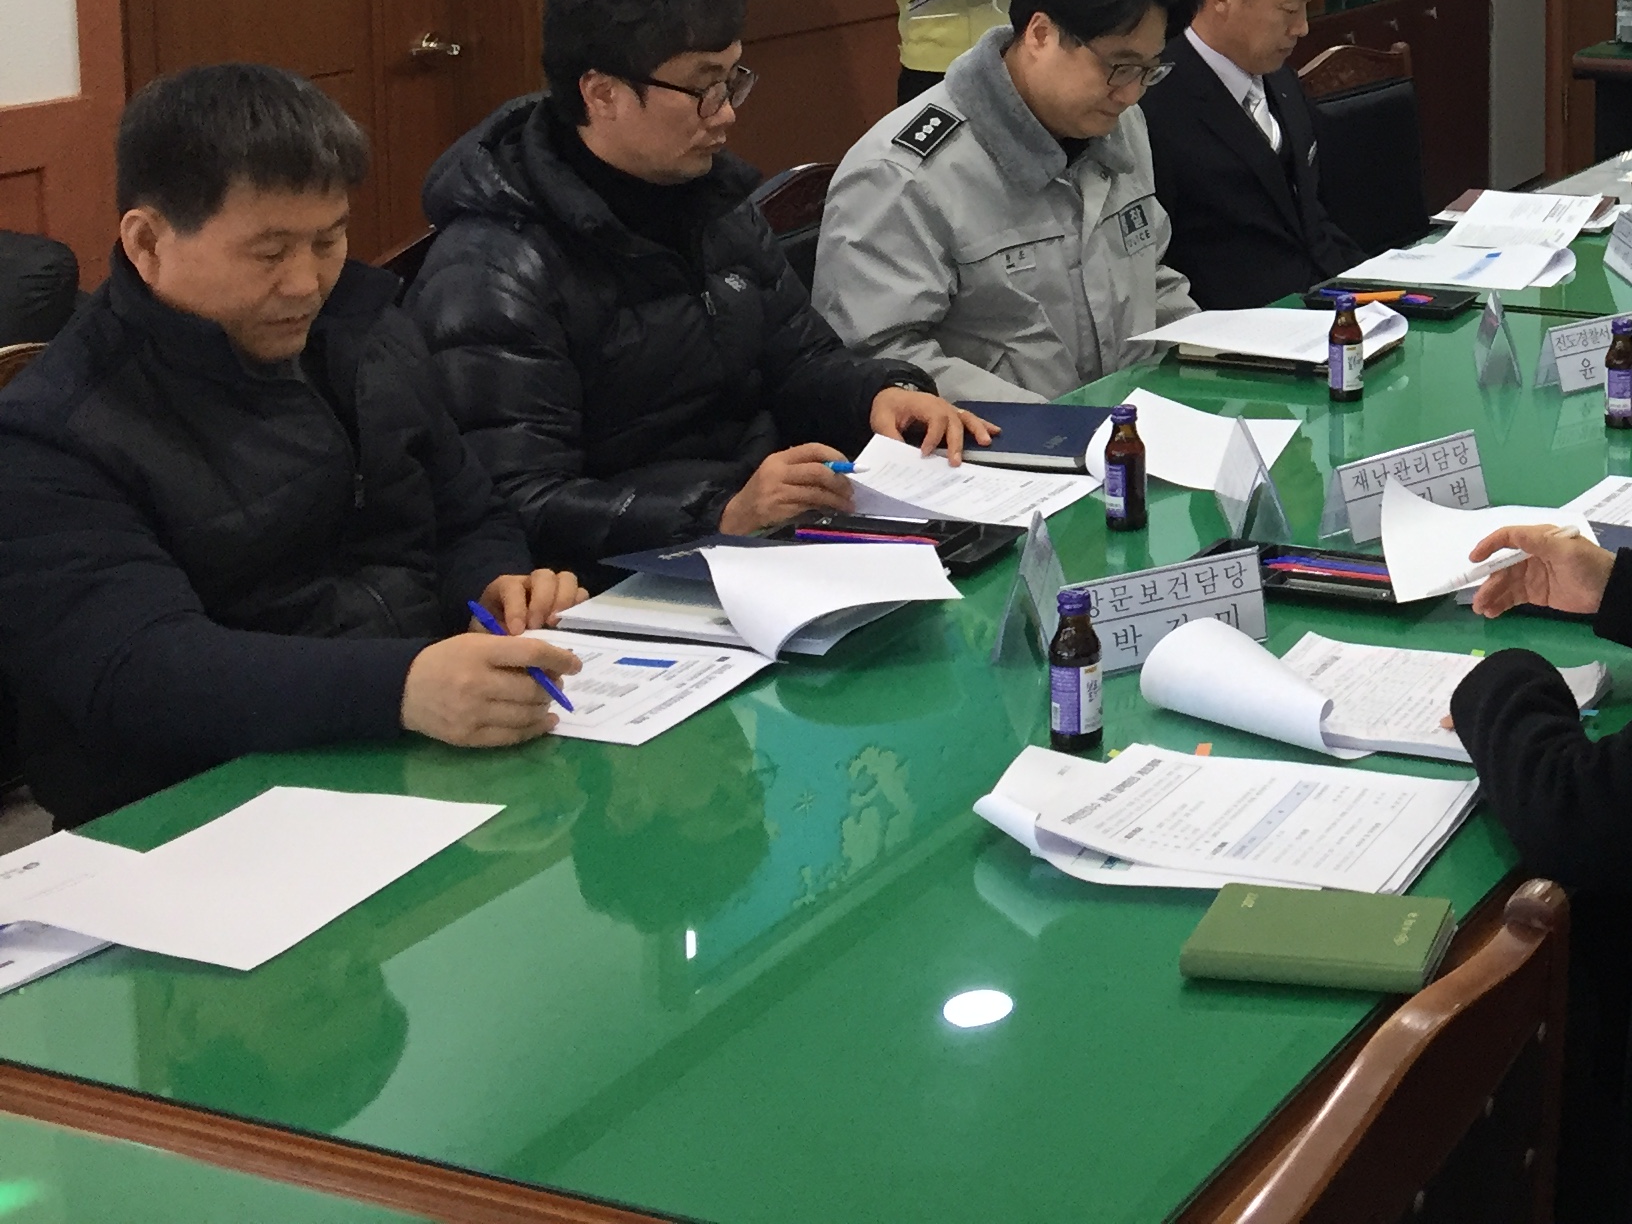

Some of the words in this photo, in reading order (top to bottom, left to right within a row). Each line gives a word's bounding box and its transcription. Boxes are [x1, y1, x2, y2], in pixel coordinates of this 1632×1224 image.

[1579, 358, 1596, 380] 윤
[1352, 441, 1469, 491] 재난관리담당
[1450, 477, 1469, 506] 범
[1112, 625, 1143, 657] 박
